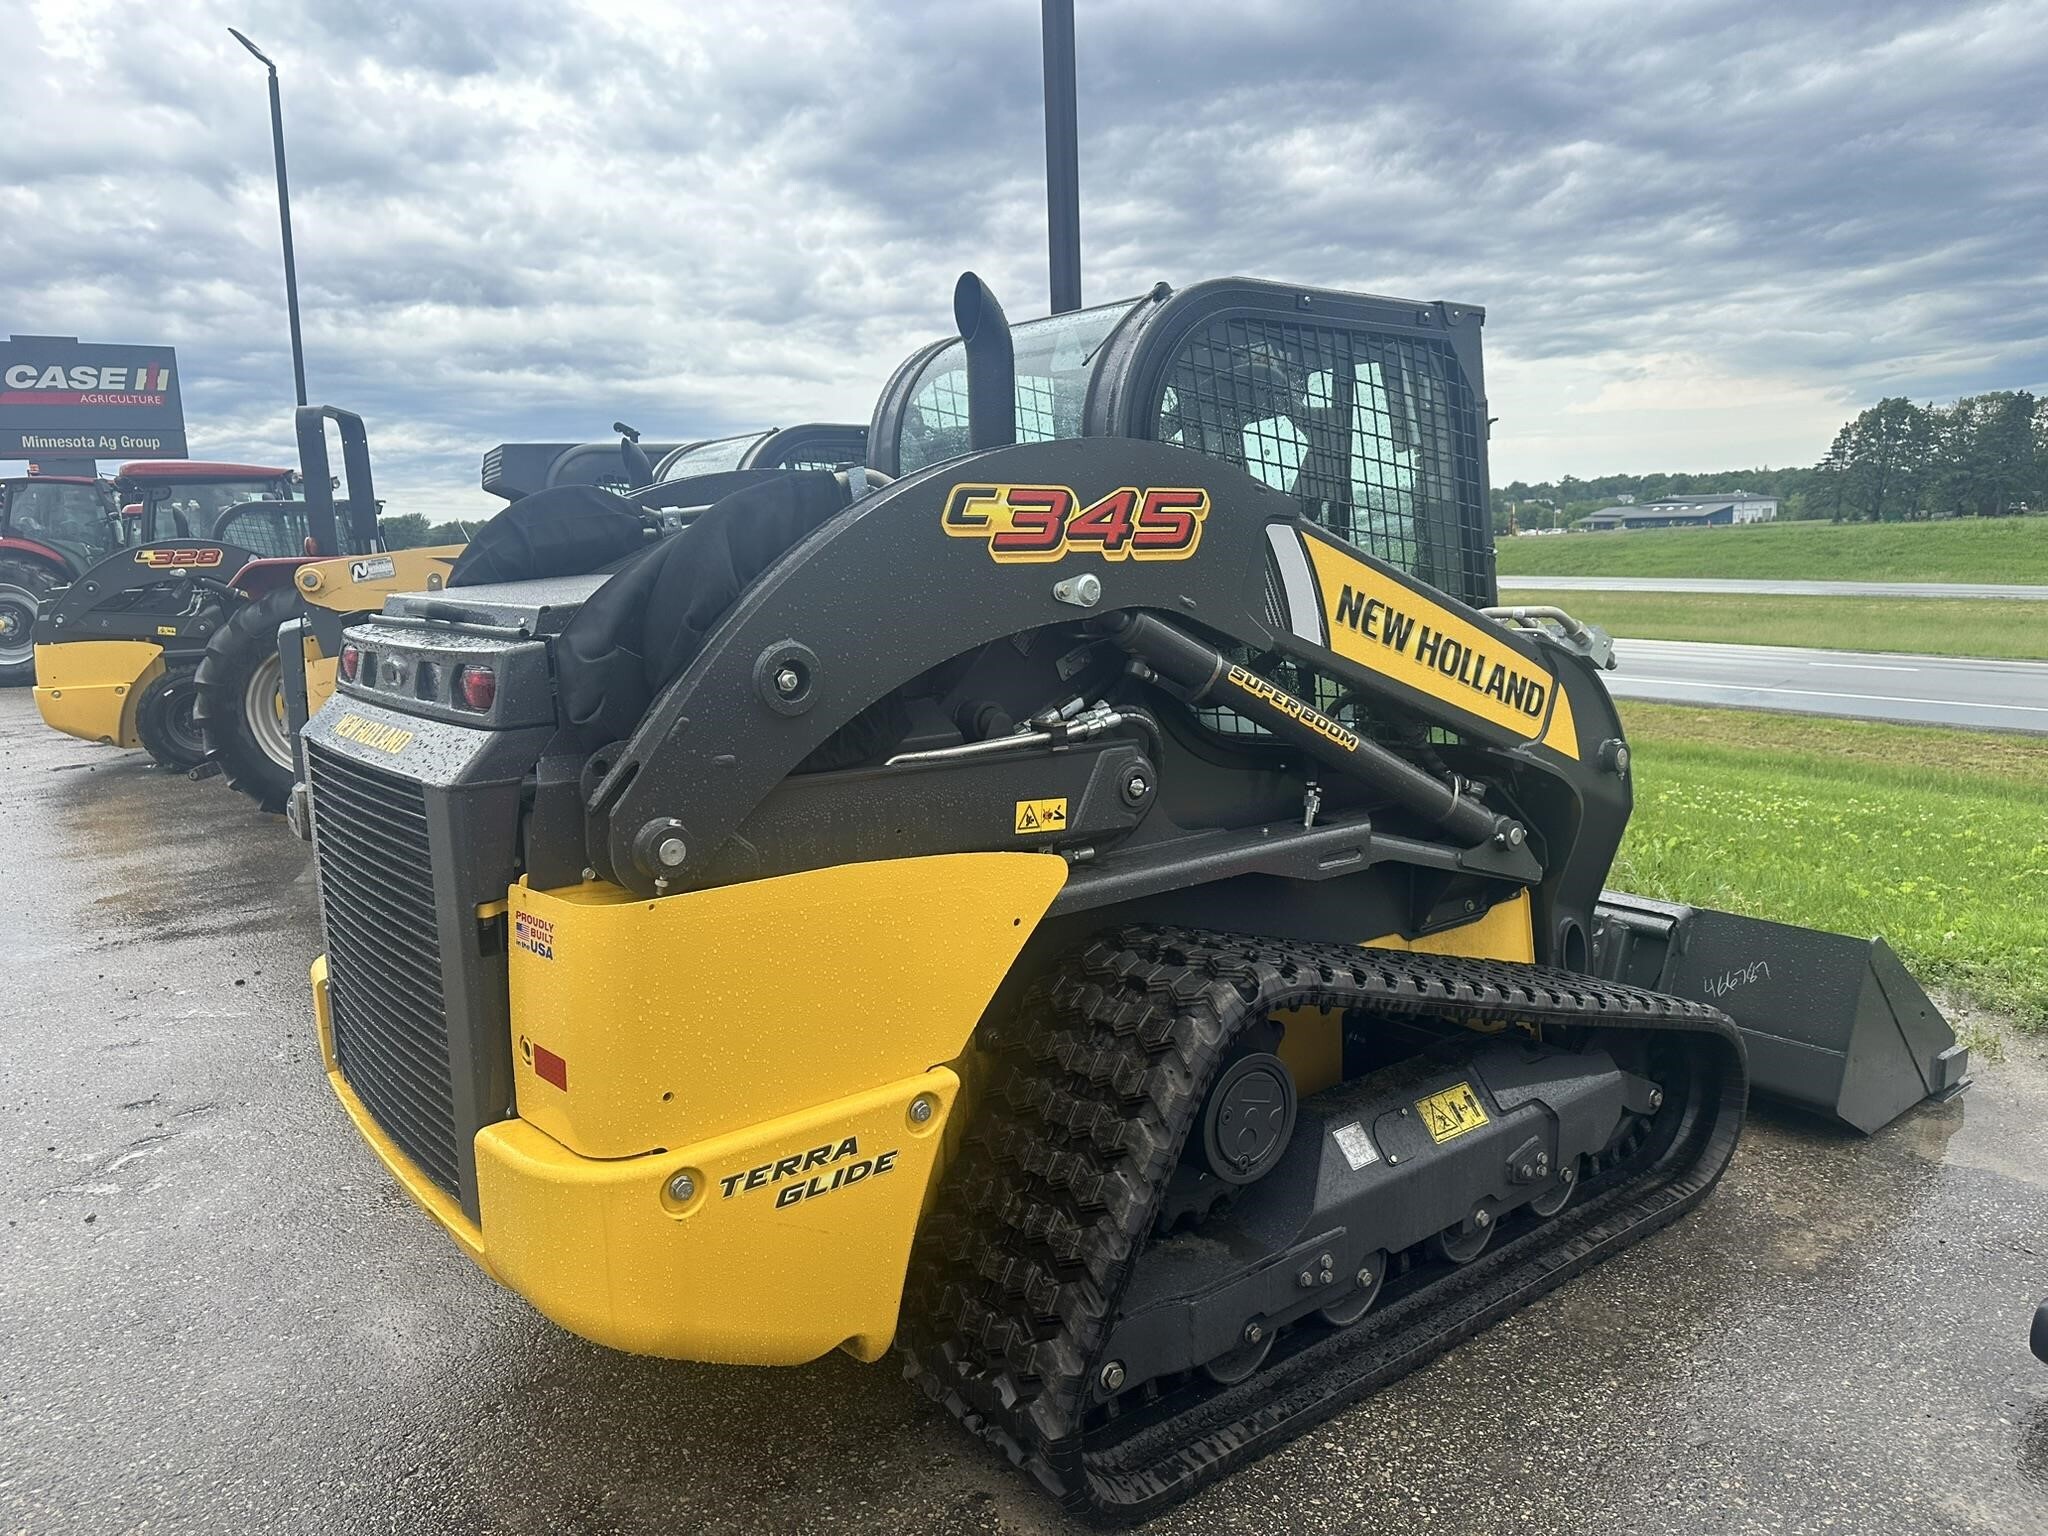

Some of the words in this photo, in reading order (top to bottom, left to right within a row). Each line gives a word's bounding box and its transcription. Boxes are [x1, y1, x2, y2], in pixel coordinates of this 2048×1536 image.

[5, 364, 128, 390] CASE
[80, 394, 161, 405] AGRICULTURE
[22, 435, 95, 448] Minnesota
[99, 436, 117, 450] Ag
[120, 437, 161, 450] Group
[942, 483, 1211, 562] C345
[134, 548, 223, 568] L328
[1335, 583, 1416, 653] NEW
[1414, 625, 1546, 719] HOLLAND
[1228, 665, 1302, 719] SUPER
[1299, 706, 1359, 752] BOOM
[333, 712, 366, 738] NEW
[350, 719, 414, 754] HOLLAND
[515, 910, 554, 933] PROUDLY
[530, 928, 554, 945] BUILT
[530, 939, 554, 960] USA
[719, 1135, 859, 1199] TERRA
[774, 1149, 899, 1210] GLIDE
